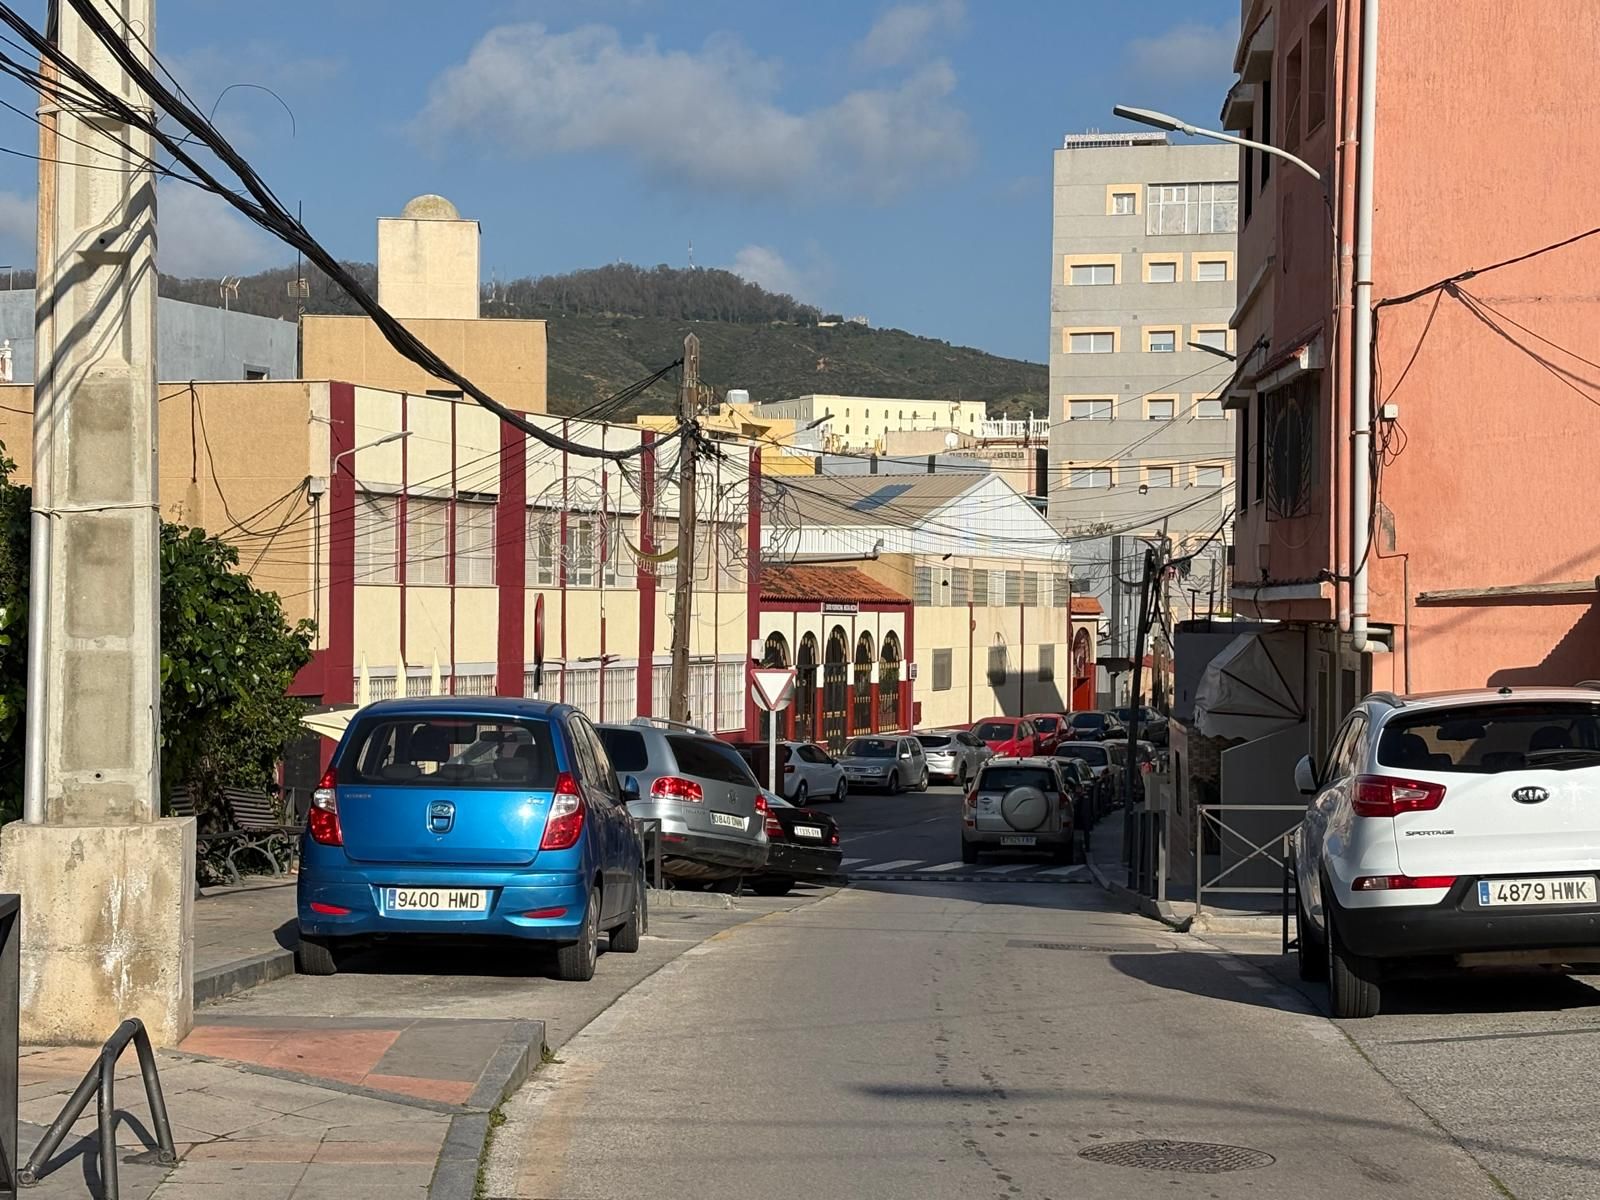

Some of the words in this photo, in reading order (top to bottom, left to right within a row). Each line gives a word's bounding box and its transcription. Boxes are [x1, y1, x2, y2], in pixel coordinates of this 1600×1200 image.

[1405, 829, 1455, 837] SPORTAGE
[397, 891, 440, 908] 9400
[448, 892, 480, 909] HMD
[1497, 882, 1546, 903] 4879
[1551, 881, 1588, 900] HWK
